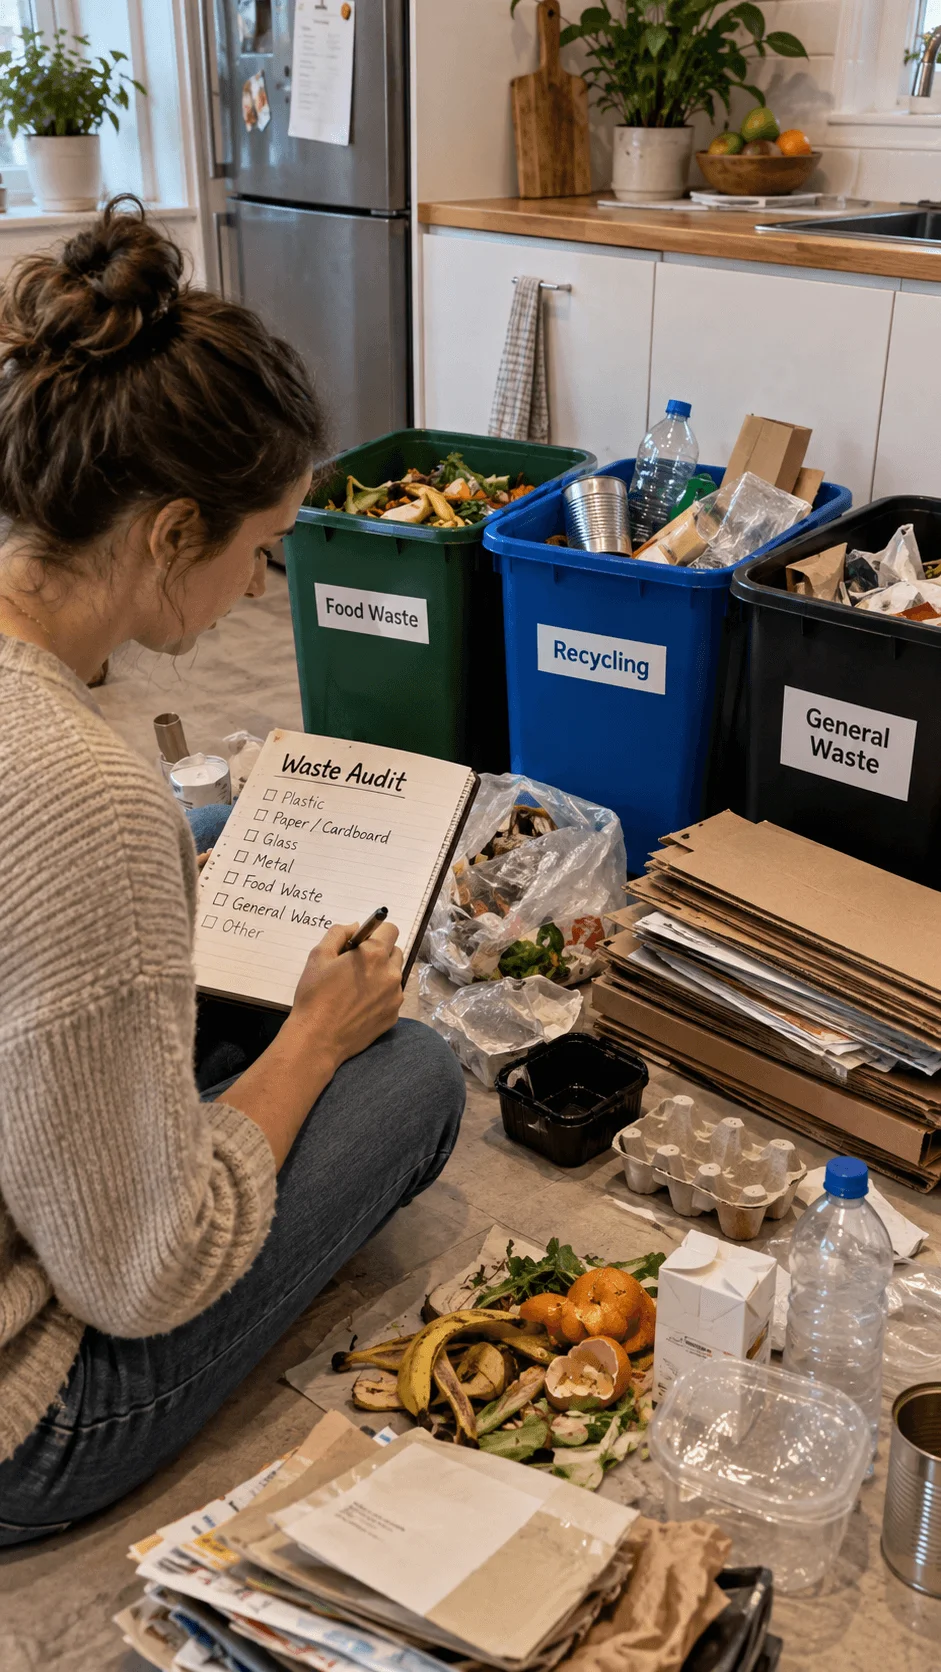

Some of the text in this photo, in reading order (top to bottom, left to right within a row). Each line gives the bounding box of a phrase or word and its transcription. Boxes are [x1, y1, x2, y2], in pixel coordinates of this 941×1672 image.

[326, 597, 419, 628] Food Waste
[553, 639, 649, 681] Recycling
[806, 707, 890, 748] General
[810, 735, 879, 774] Waste
[281, 753, 408, 792] Waste Audit
[281, 790, 325, 810] Plastic
[262, 832, 299, 850] Glass
[252, 853, 295, 873] Metal
[242, 874, 323, 903] Food Waste
[222, 918, 265, 939] Other
[232, 896, 333, 930] General Waste
